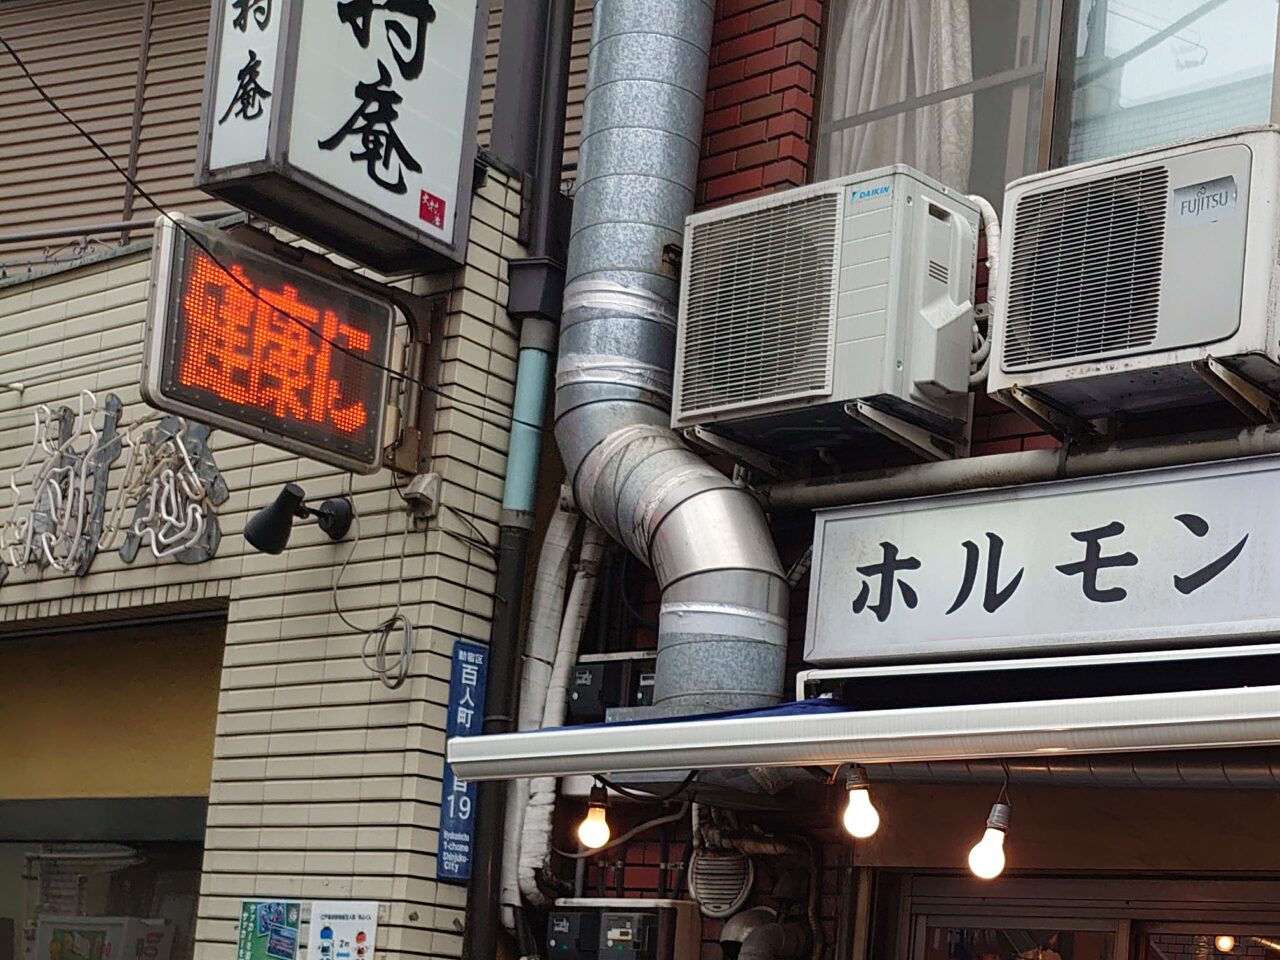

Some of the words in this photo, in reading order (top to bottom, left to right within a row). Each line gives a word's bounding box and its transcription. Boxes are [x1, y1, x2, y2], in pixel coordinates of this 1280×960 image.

[860, 185, 890, 199] DAIKIN
[1180, 190, 1229, 216] FUJITSU
[852, 512, 1247, 622] ホルモン
